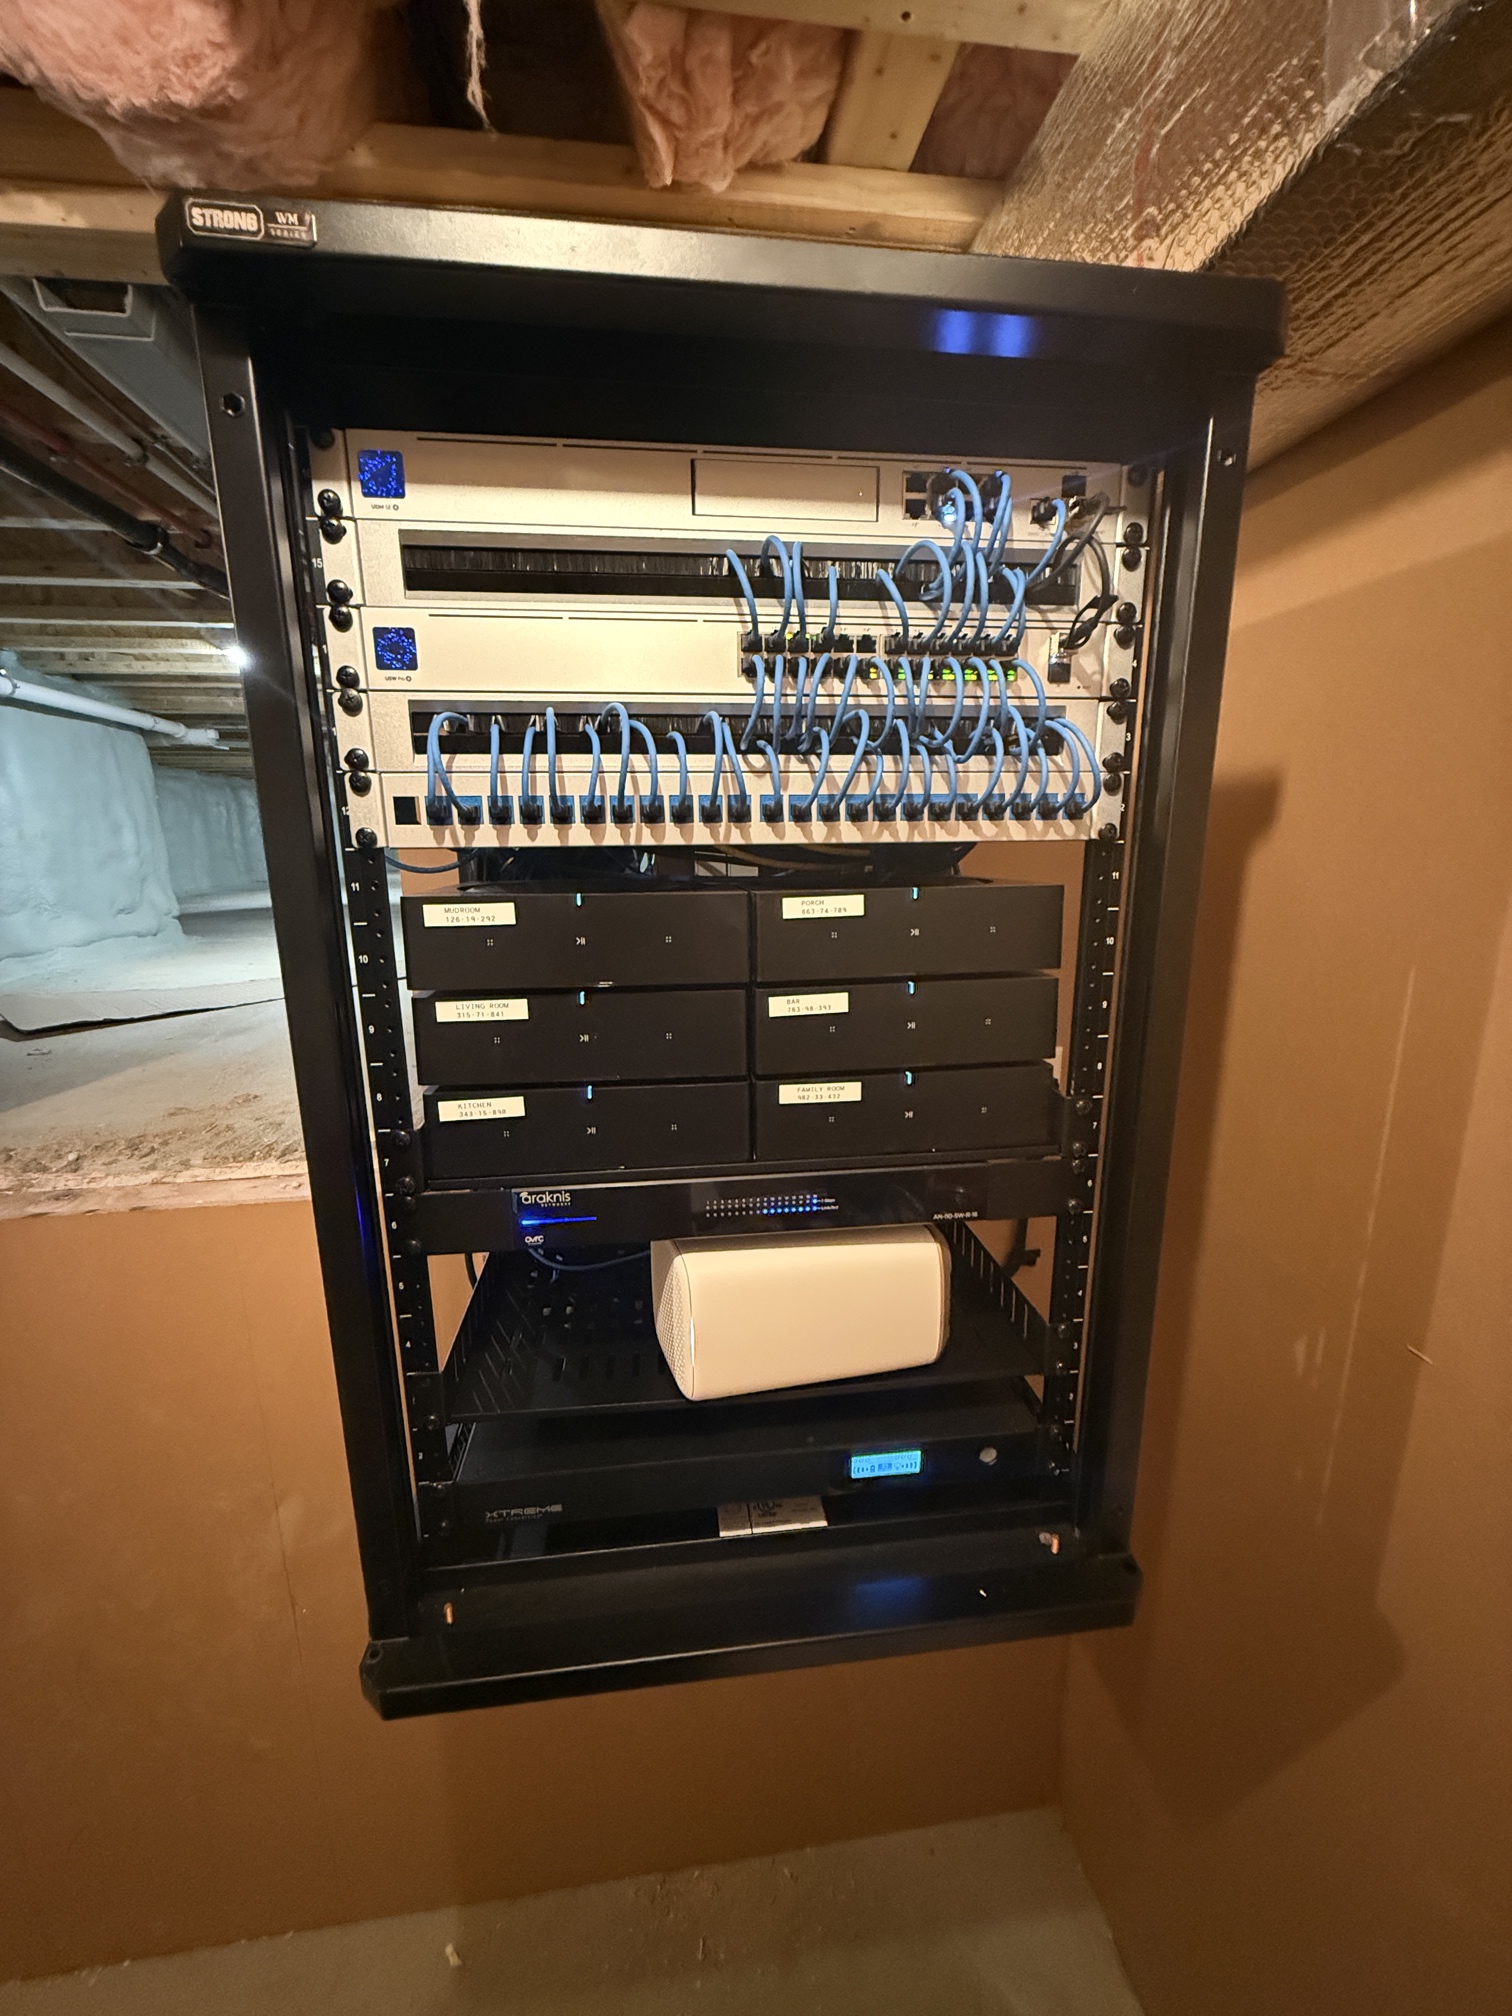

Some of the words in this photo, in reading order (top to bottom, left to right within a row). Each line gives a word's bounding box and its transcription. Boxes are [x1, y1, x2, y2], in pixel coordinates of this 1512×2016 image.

[191, 207, 259, 232] STRONG
[275, 211, 299, 225] WM
[312, 557, 323, 569] 15
[1112, 871, 1120, 880] 11
[351, 882, 360, 892] 11
[1106, 936, 1115, 945] 10
[358, 954, 369, 964] 10
[1102, 1000, 1108, 1009] 9
[368, 1024, 375, 1034] 9
[376, 1092, 383, 1102] 8
[457, 1101, 492, 1109] KITCHEN
[1092, 1121, 1098, 1130] 7
[383, 1158, 390, 1167] 7
[519, 1190, 571, 1204] araknis
[391, 1221, 397, 1230] 6
[398, 1281, 404, 1290] 5
[485, 1504, 562, 1518] XTREME
